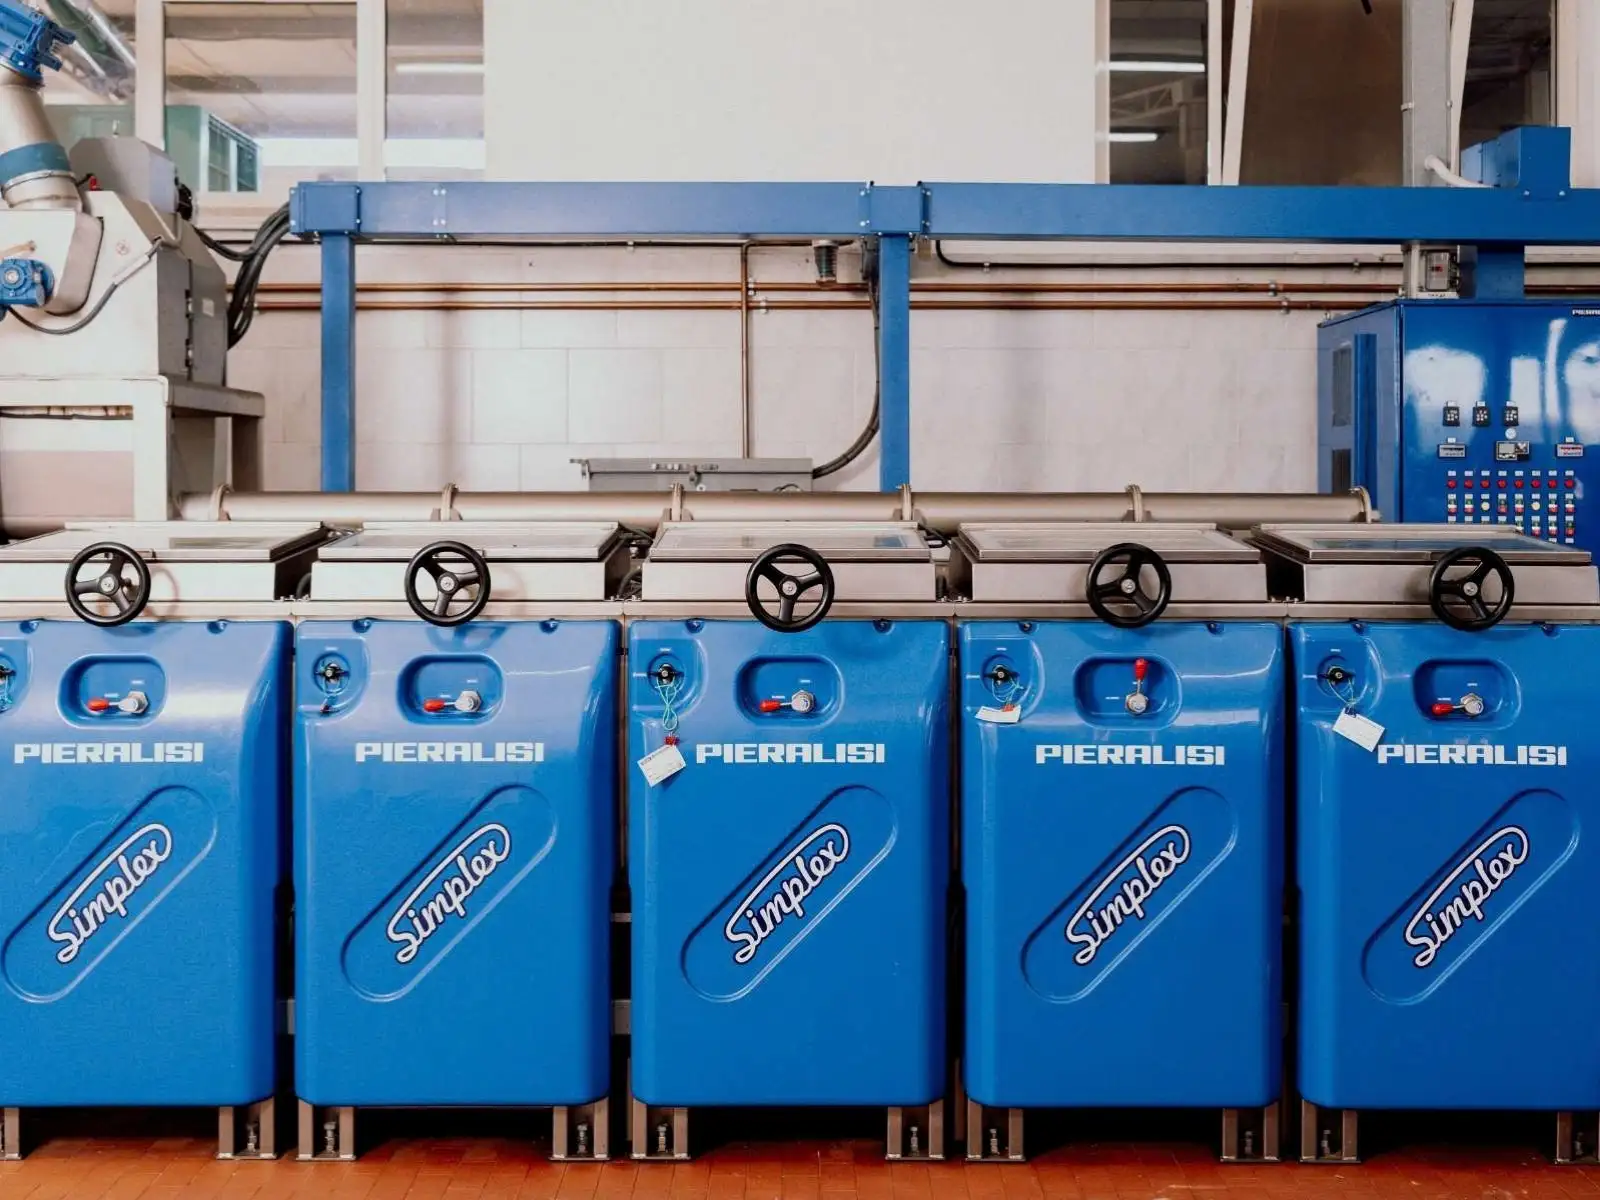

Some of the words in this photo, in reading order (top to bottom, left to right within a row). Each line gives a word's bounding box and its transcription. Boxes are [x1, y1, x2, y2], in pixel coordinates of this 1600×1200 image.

[14, 742, 205, 764] PIERALISI
[355, 742, 545, 763] PIERALISI
[696, 743, 886, 763] PIERALISI
[1035, 745, 1225, 766] PIERALISI
[1377, 744, 1568, 767] PIERALISI
[47, 823, 172, 964] Simplex
[386, 823, 511, 964] Simplex
[725, 823, 850, 965] Simplex
[1065, 824, 1191, 966] Simplex
[1404, 826, 1529, 968] Simplex
